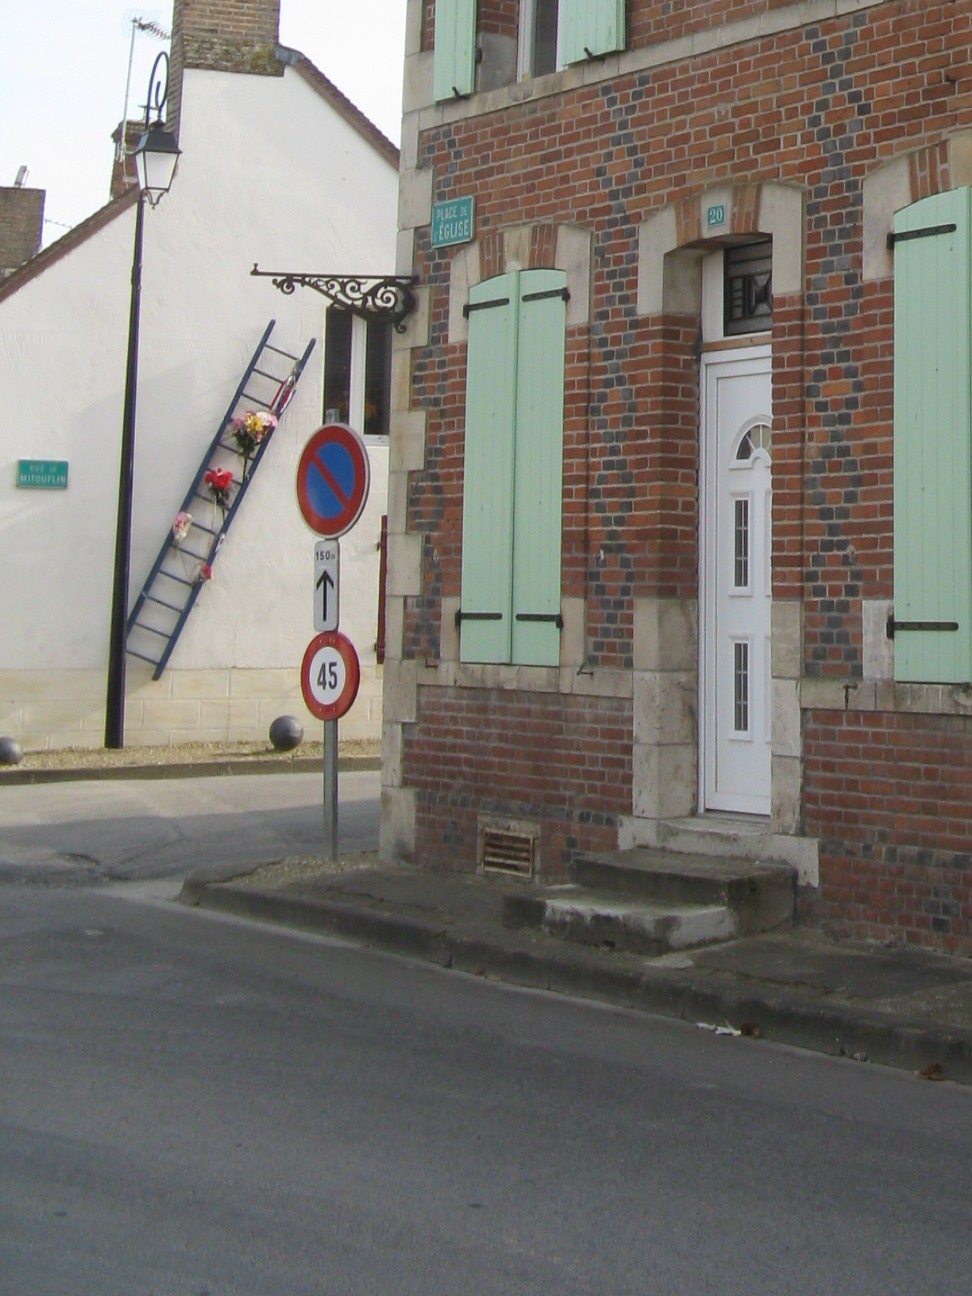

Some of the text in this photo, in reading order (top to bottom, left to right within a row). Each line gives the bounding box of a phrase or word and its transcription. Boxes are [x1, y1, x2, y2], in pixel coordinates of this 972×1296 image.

[436, 205, 458, 221] PLACE
[709, 207, 723, 223] 20
[316, 661, 338, 690] 45
